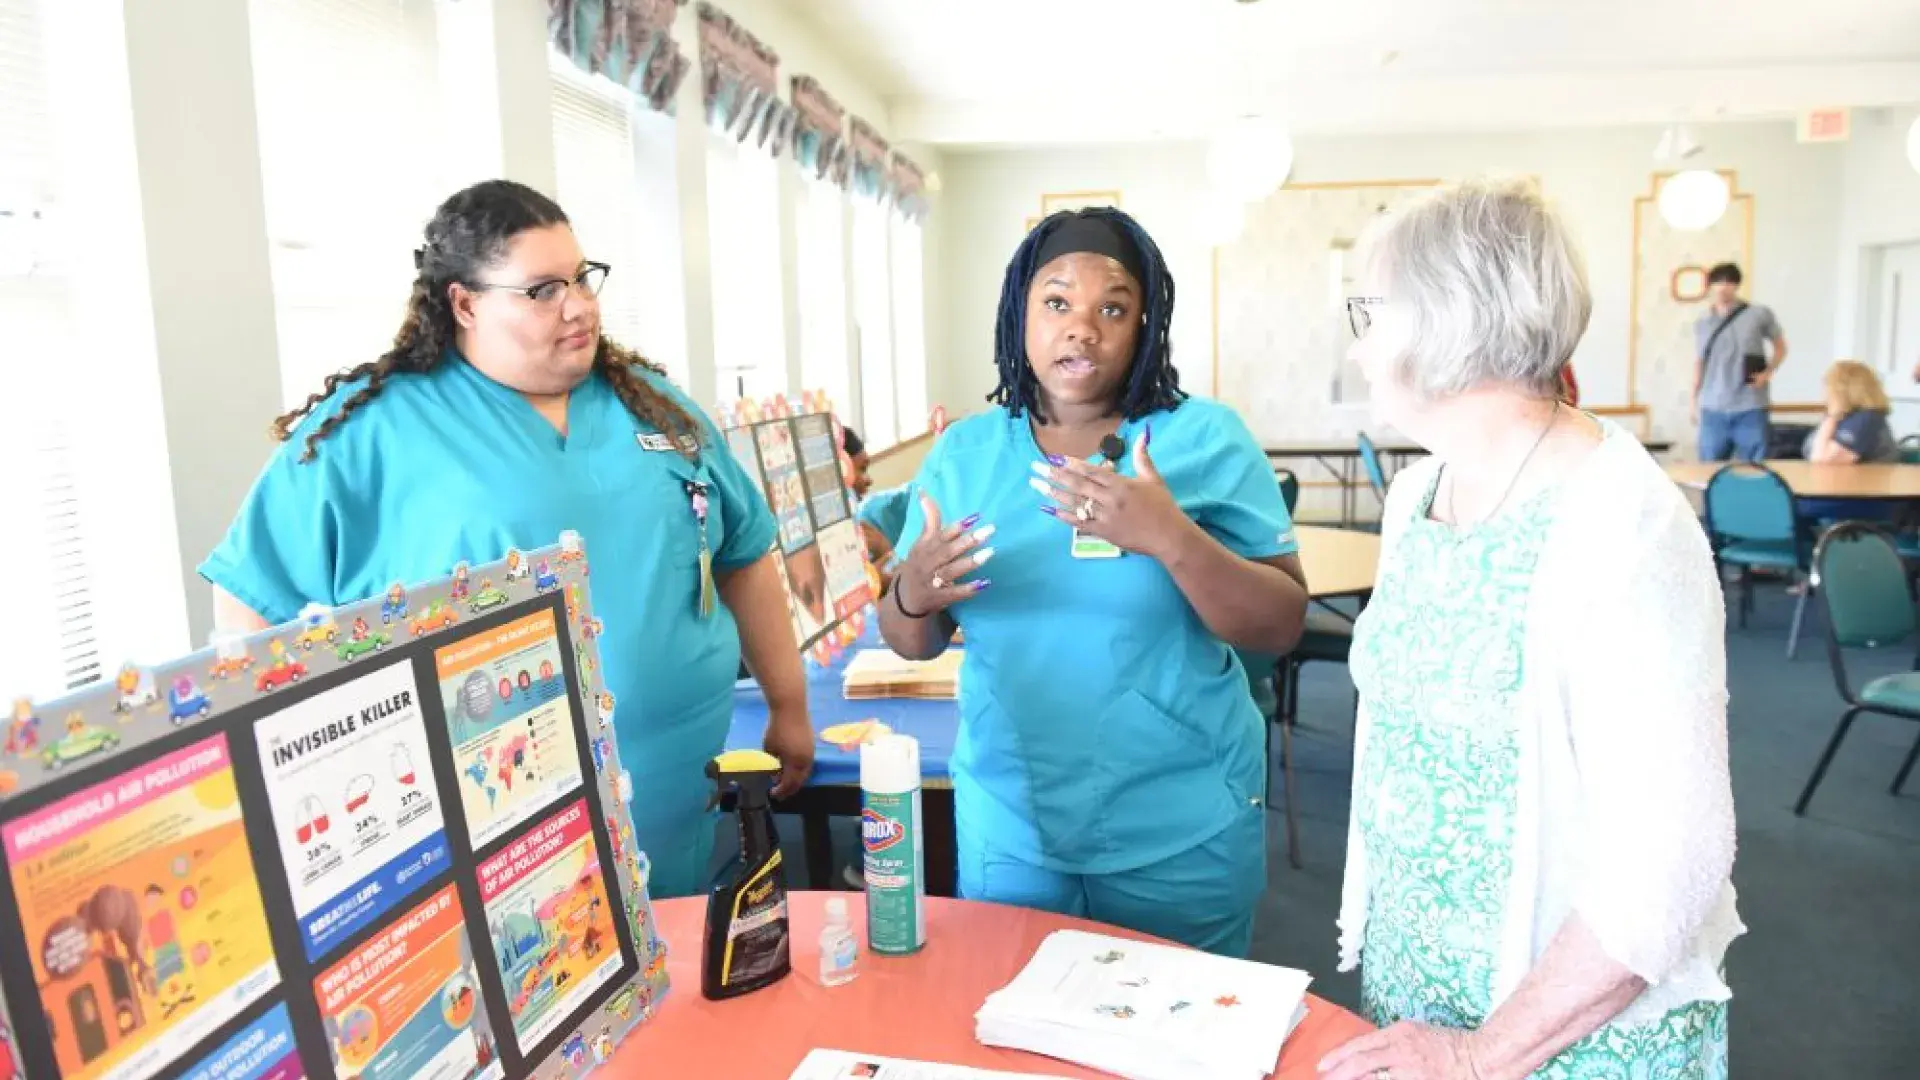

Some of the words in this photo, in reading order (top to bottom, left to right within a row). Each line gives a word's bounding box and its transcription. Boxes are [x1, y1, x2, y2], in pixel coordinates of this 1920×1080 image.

[272, 715, 356, 768] INVISIBLE
[360, 690, 412, 726] KILLER
[14, 792, 116, 850] HOUSEHOLD
[117, 778, 144, 804] AIR
[145, 746, 222, 789] POLLUTION
[481, 852, 508, 878] WHAT
[509, 842, 527, 861] ARE
[527, 830, 544, 849] THE
[544, 806, 581, 836] SOURCES
[484, 876, 498, 894] OF
[498, 865, 514, 884] AIR
[321, 967, 350, 993] WHO
[350, 955, 362, 972] IS
[362, 934, 391, 963] MOST
[391, 901, 439, 942] IMPACTED
[439, 892, 451, 909] BY
[326, 986, 346, 1010] AIR
[209, 1028, 266, 1077] OUTDOOR
[226, 1031, 287, 1080] POLLUTION
